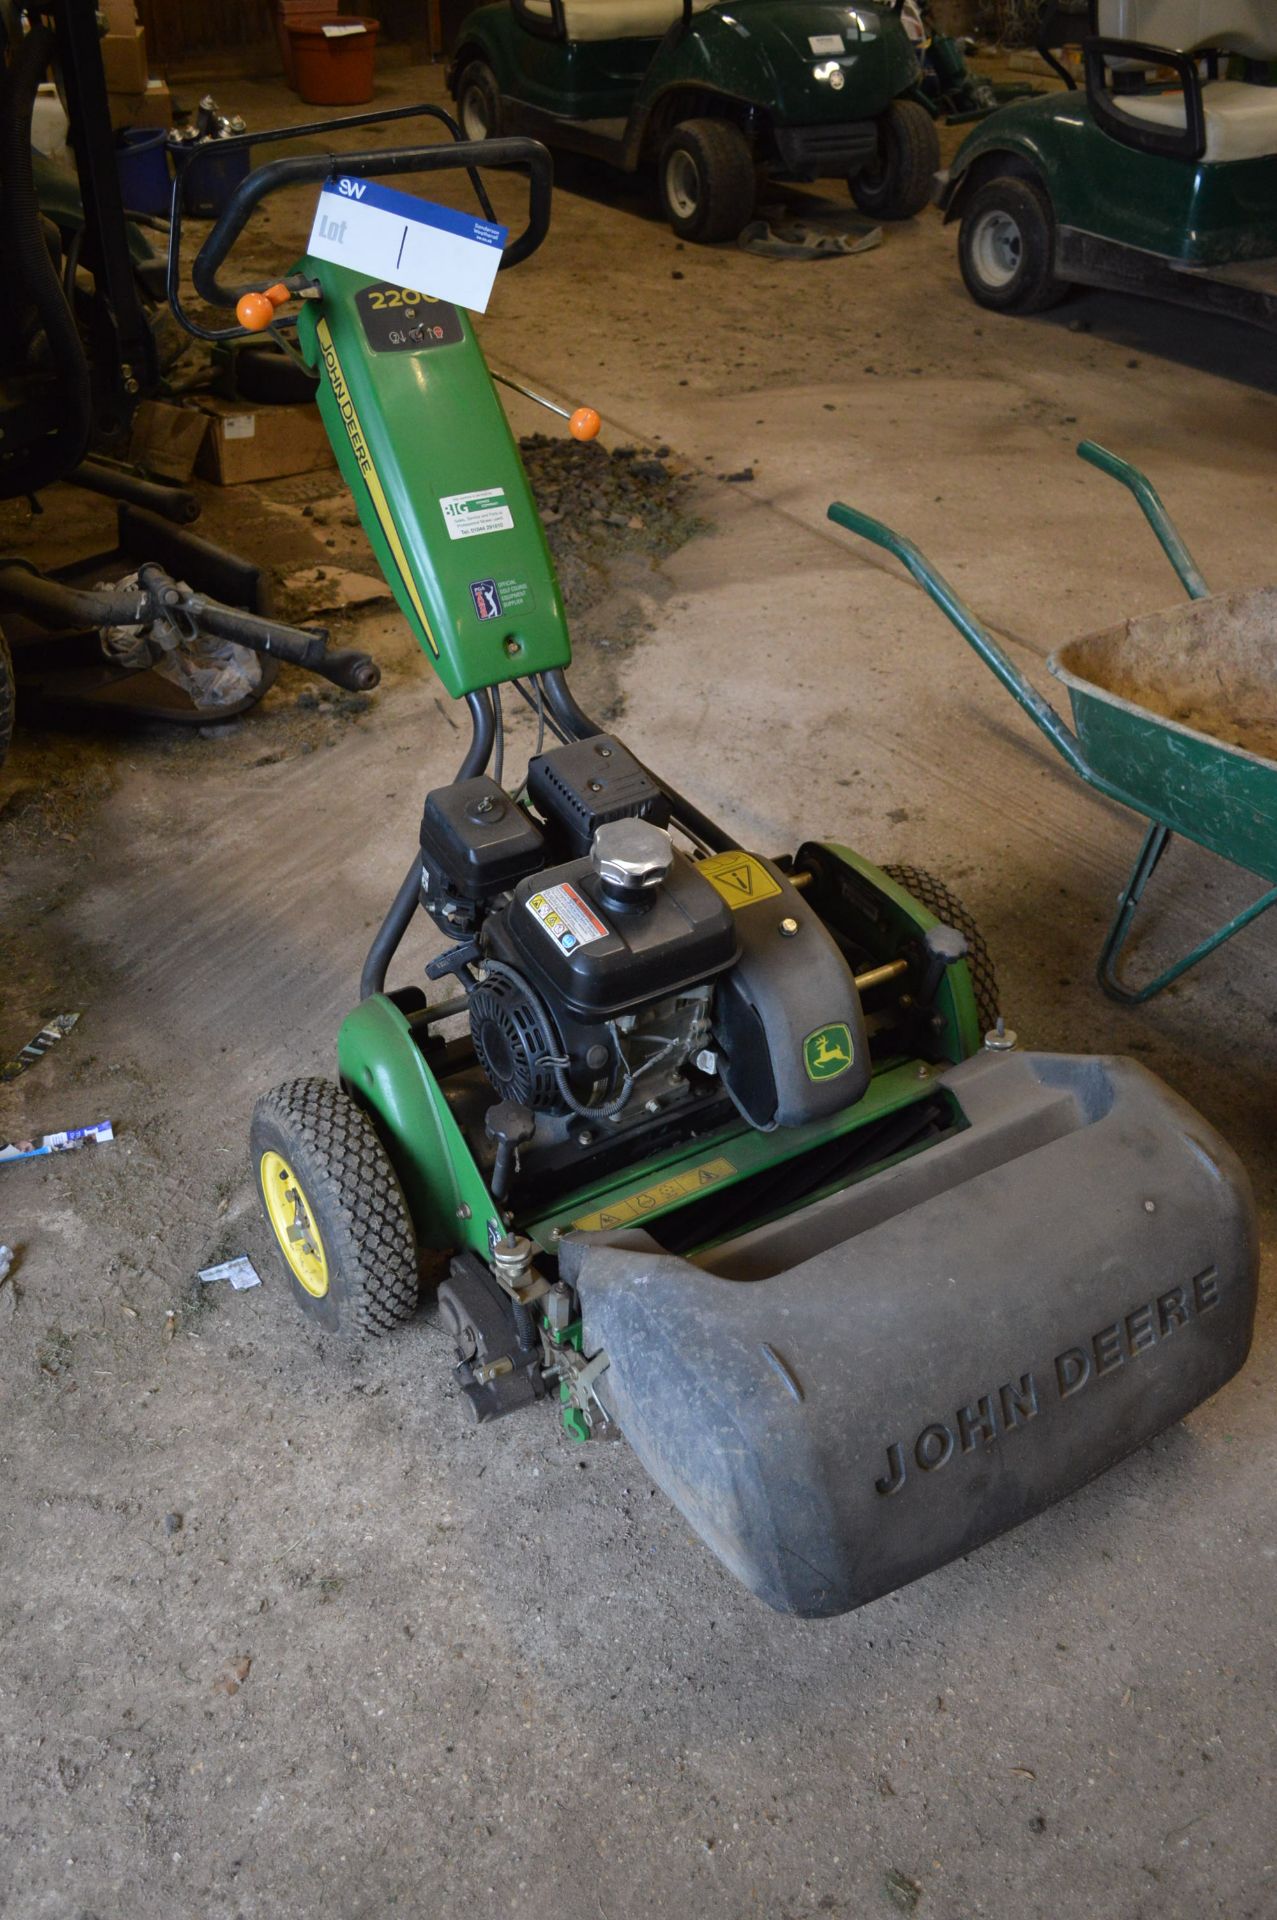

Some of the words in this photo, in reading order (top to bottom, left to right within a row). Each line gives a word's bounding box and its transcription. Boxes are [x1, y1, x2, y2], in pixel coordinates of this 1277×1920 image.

[338, 178, 367, 200] SW
[319, 214, 347, 245] Lot
[320, 341, 346, 399] JOHN
[341, 400, 372, 476] DEERE
[444, 503, 469, 516] BIG
[874, 1372, 1039, 1495] JOHN
[1053, 1263, 1221, 1400] DEERE
